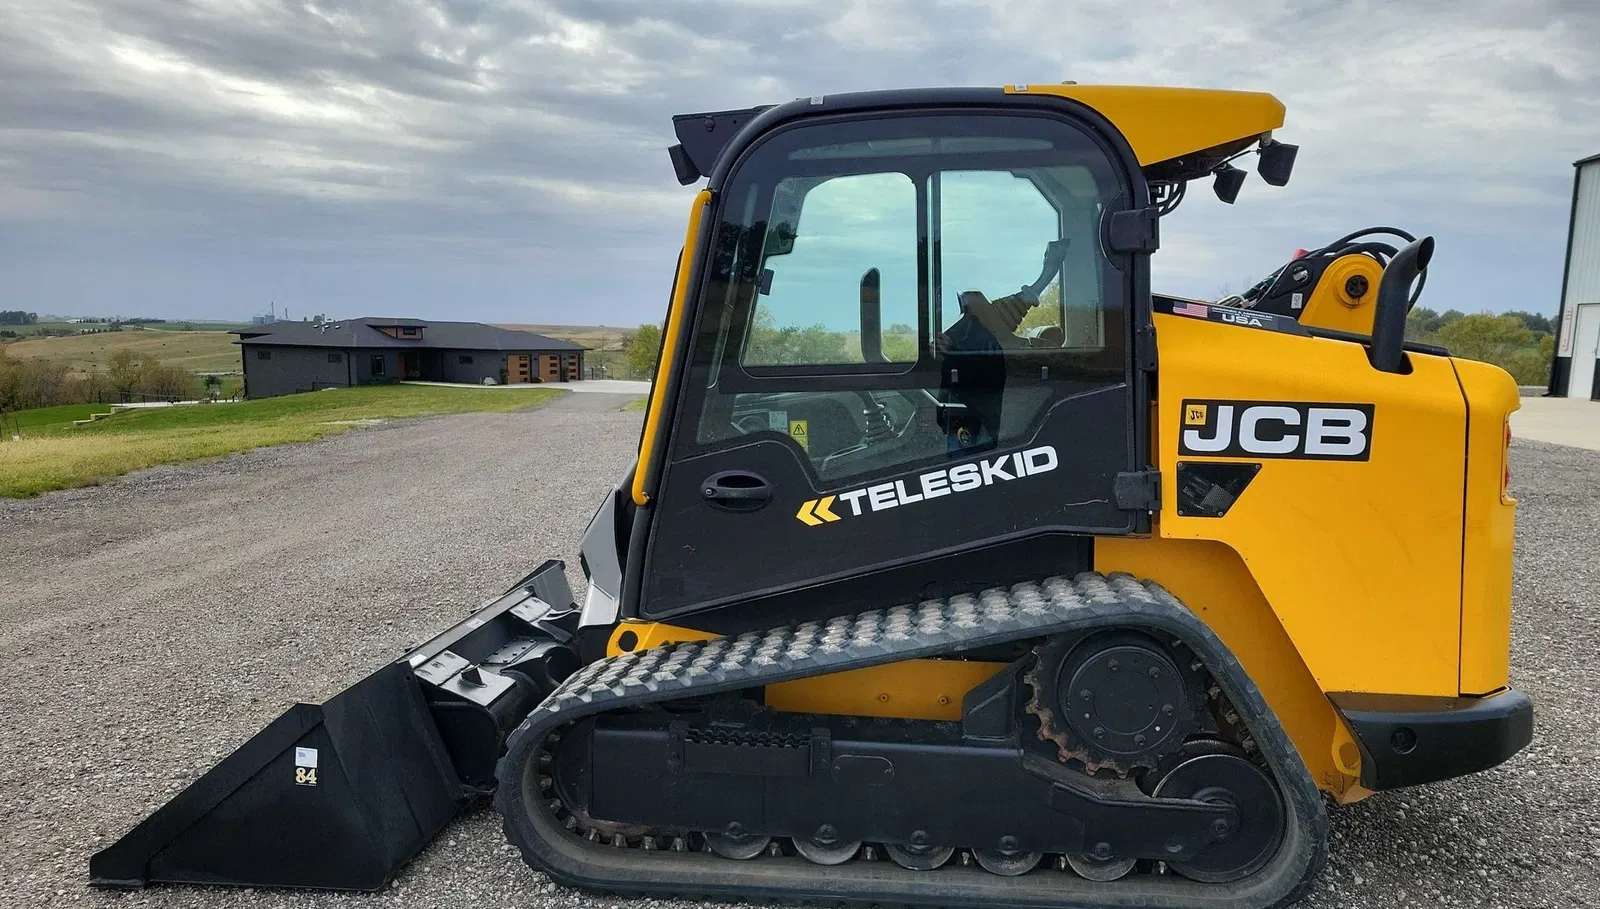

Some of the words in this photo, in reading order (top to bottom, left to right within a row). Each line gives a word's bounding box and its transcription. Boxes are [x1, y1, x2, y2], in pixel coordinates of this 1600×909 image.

[1222, 313, 1263, 327] USA
[1190, 410, 1204, 420] JCB
[1183, 405, 1367, 456] JCB
[839, 445, 1059, 516] TELESKID
[295, 767, 317, 784] 84
